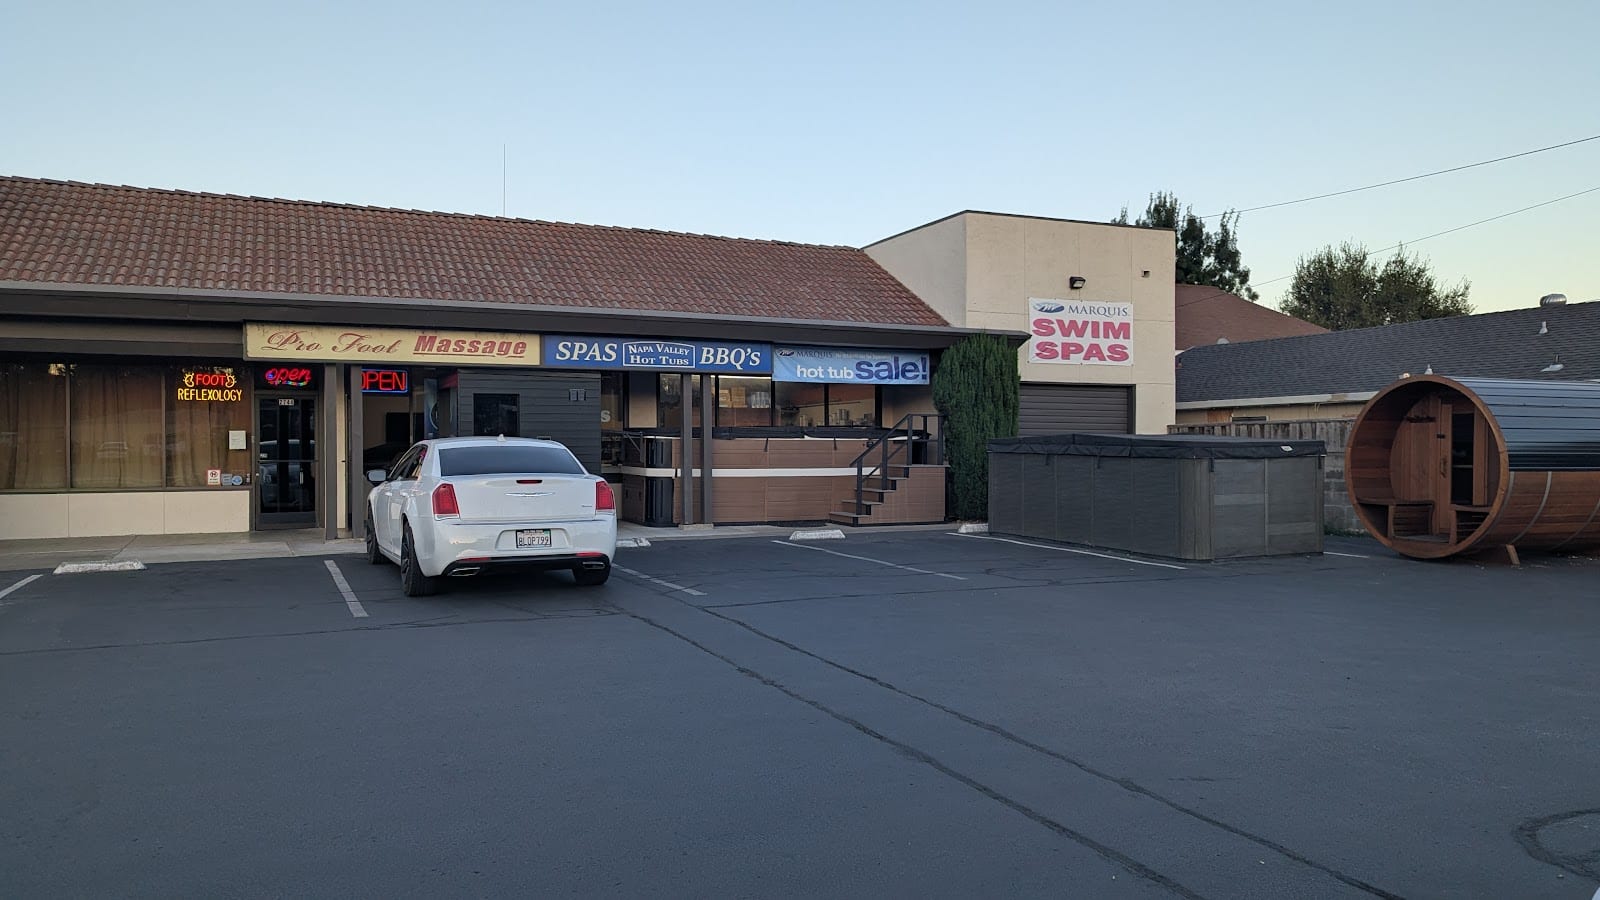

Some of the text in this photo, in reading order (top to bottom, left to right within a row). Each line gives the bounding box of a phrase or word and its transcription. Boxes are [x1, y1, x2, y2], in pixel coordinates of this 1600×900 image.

[1068, 305, 1128, 317] MARQUIS
[1032, 318, 1131, 340] SWIM
[261, 330, 527, 357] Pro Foot Massage
[555, 341, 618, 362] SPAS
[1035, 341, 1130, 362] SPAS
[265, 367, 311, 384] open
[796, 365, 824, 378] hot
[828, 366, 854, 379] tub
[855, 355, 928, 380] sale!
[195, 373, 227, 386] FOOT
[178, 388, 242, 402] REFLEXOLOGY
